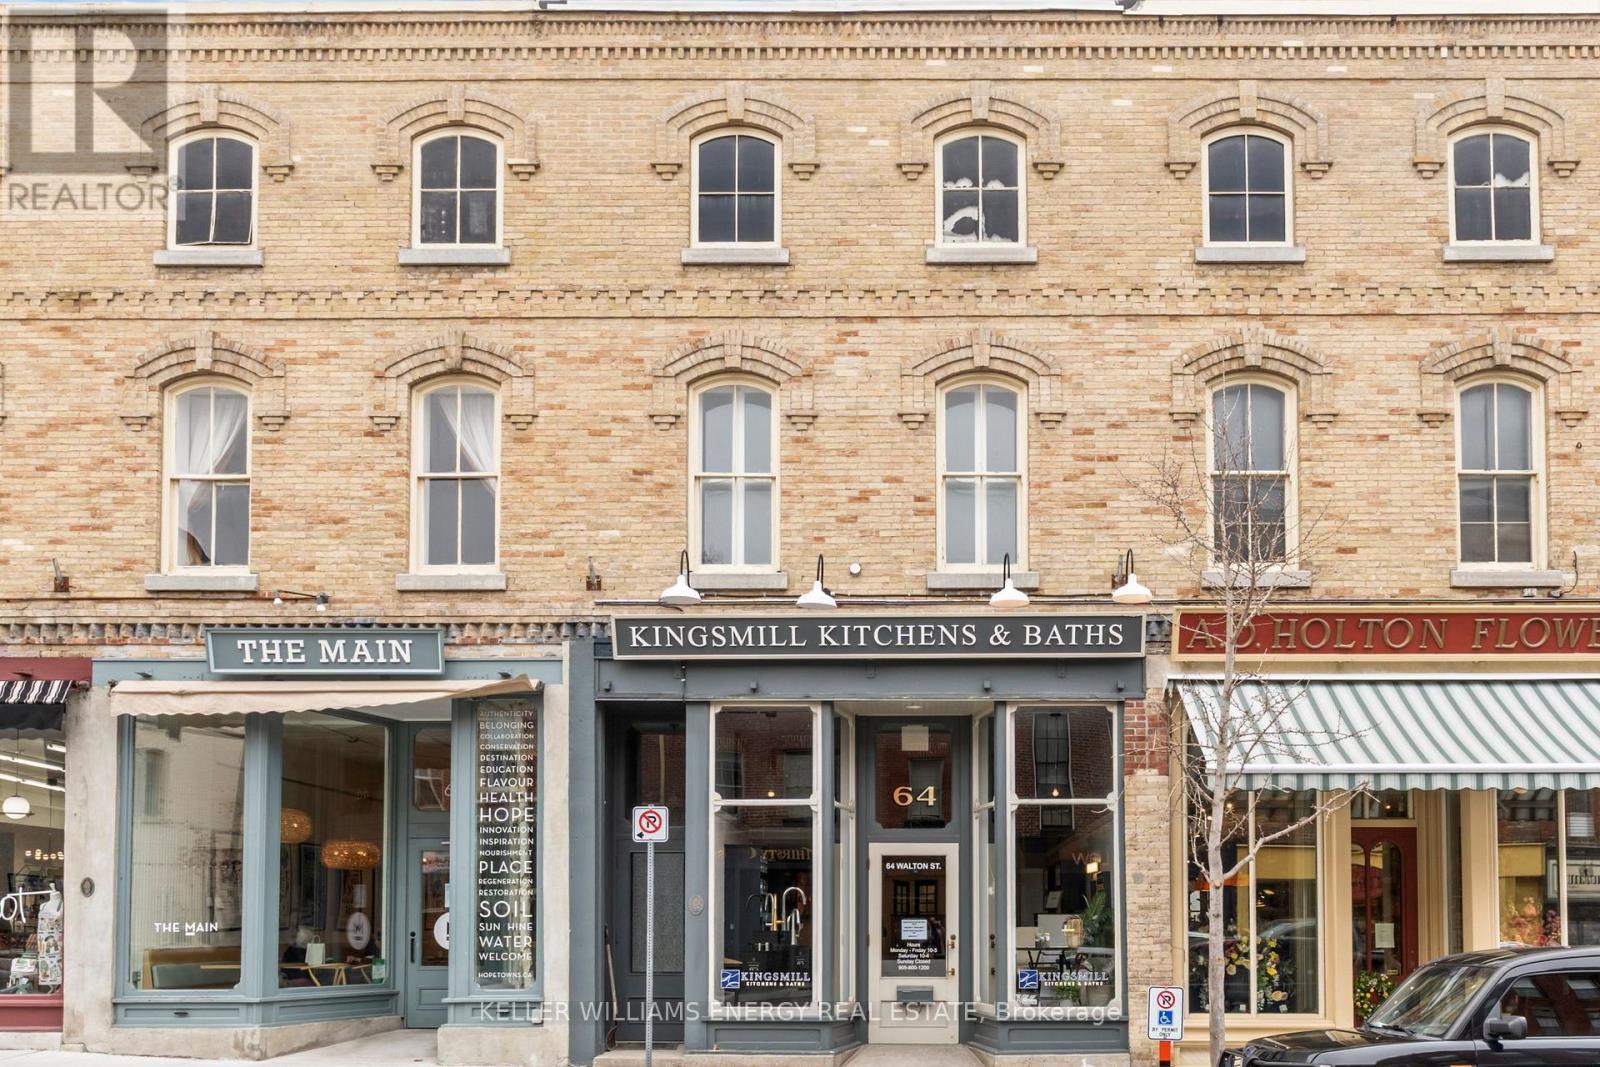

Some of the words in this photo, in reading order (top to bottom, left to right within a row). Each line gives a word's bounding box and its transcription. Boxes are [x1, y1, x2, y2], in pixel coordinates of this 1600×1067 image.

[629, 625, 807, 647] KINGSMILL
[818, 624, 977, 646] KITCHENS
[989, 624, 1012, 646] &
[1023, 624, 1124, 646] BATHS
[1271, 617, 1448, 649] HOLTON
[237, 639, 306, 664] THE
[318, 639, 413, 664] MAIN
[480, 721, 534, 729] BELONGING
[480, 765, 533, 774] EDUCATION
[480, 777, 534, 787] FLAVOUR
[480, 792, 534, 803] HEALTH
[893, 786, 937, 806] 64
[480, 807, 534, 822] HOPE
[479, 826, 534, 834] INNOVATION
[479, 860, 533, 874] PLACE
[886, 862, 895, 870] 64
[896, 862, 929, 870] WALTON
[930, 862, 942, 870] ST.
[480, 901, 533, 918] SOIL
[153, 922, 180, 933] THE
[184, 922, 218, 936] MAIN
[479, 935, 533, 948] WATER
[479, 952, 532, 960] WELCOME
[741, 972, 811, 981] KINGSMILL
[1039, 972, 1109, 981] KINGSMILL
